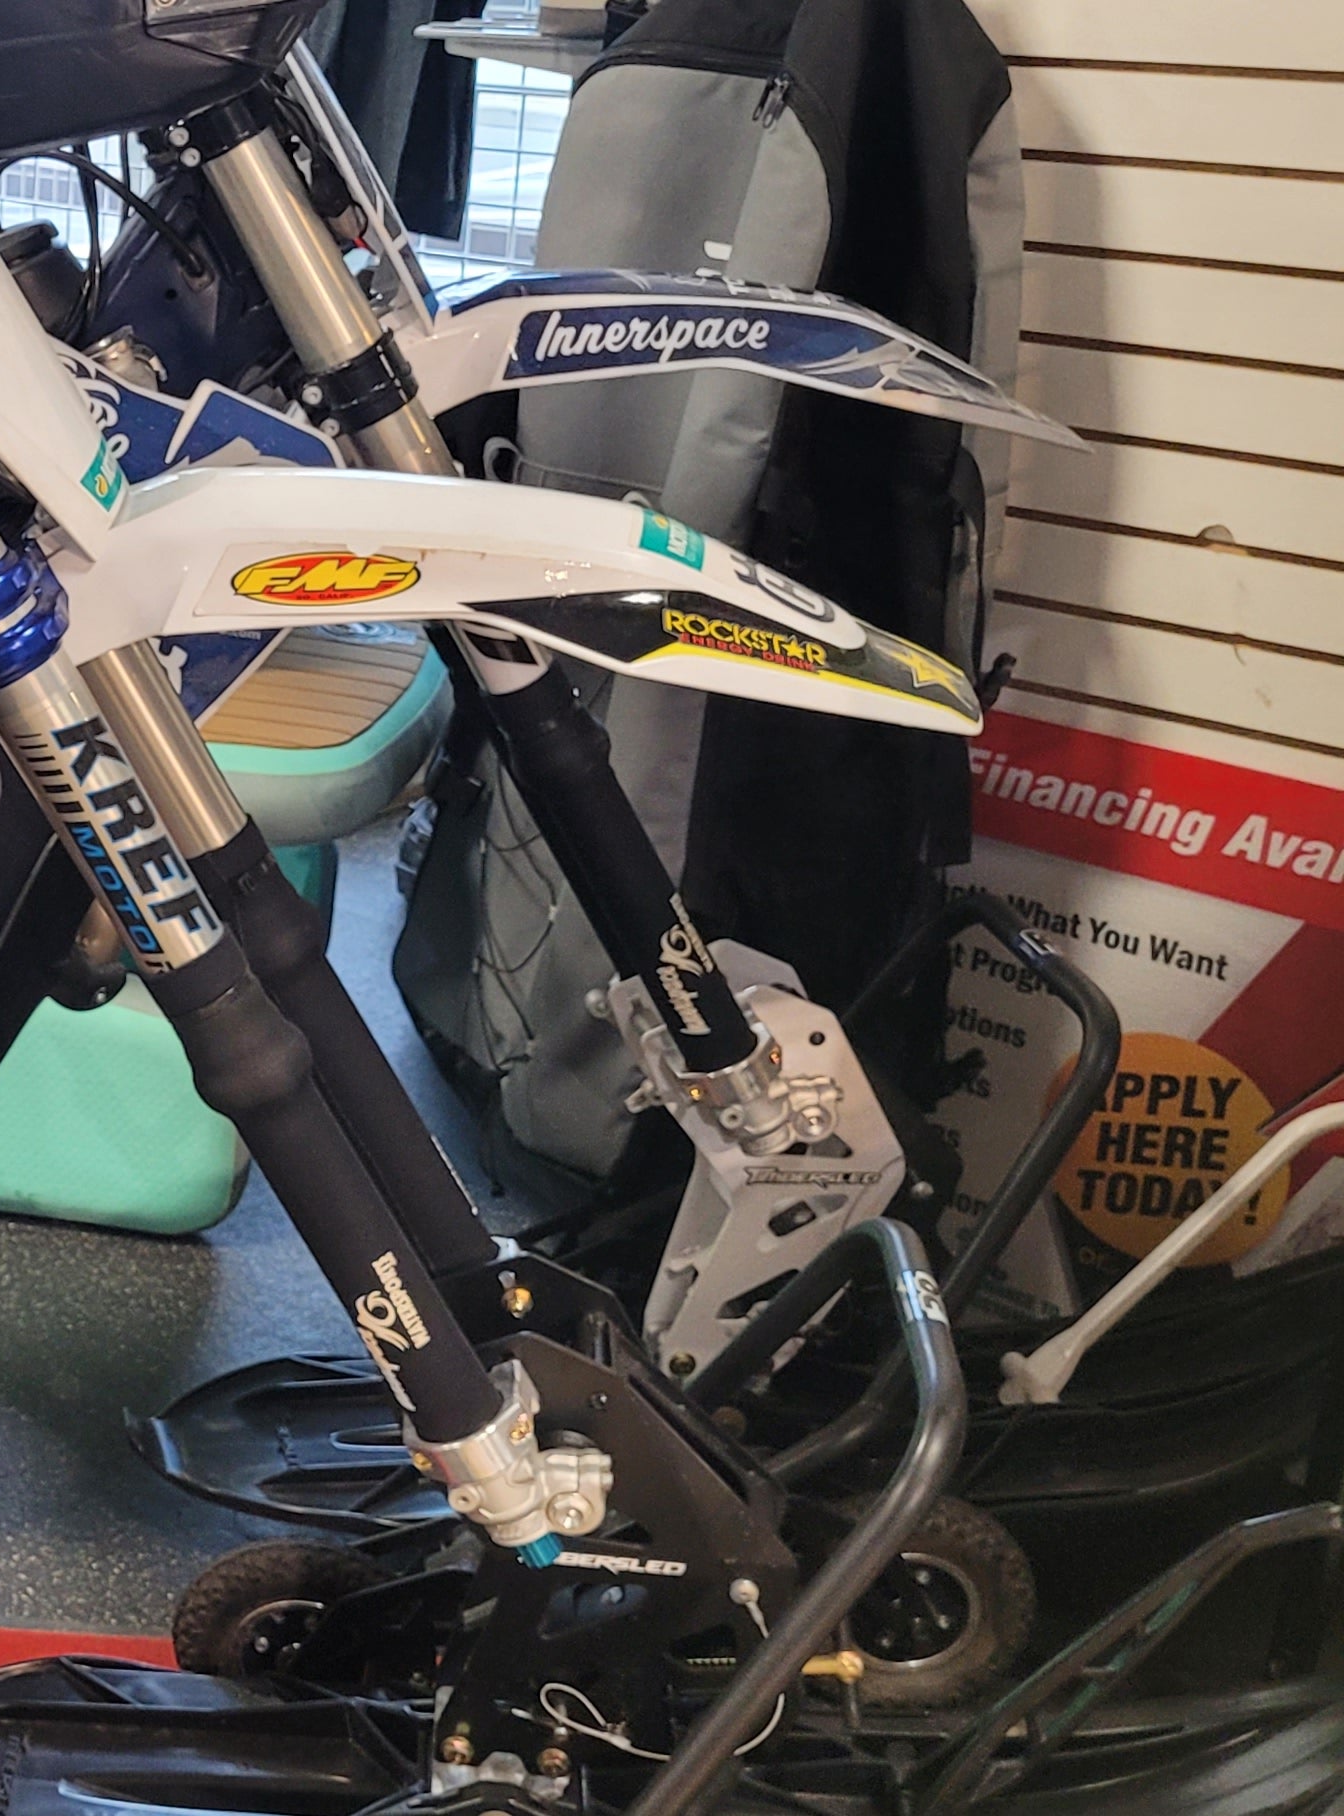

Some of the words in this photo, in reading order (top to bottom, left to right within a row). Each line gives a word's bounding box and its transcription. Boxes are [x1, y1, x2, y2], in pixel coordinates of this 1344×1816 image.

[534, 309, 771, 364] Innerspace
[234, 557, 418, 597] FMF
[663, 609, 828, 667] ROCKSTAR
[679, 632, 753, 658] ENERGY
[967, 745, 1216, 858] Financing
[69, 822, 159, 952] MOTO
[1088, 917, 1140, 957] You
[1149, 934, 1230, 982] Want
[1095, 1121, 1231, 1172] HERE
